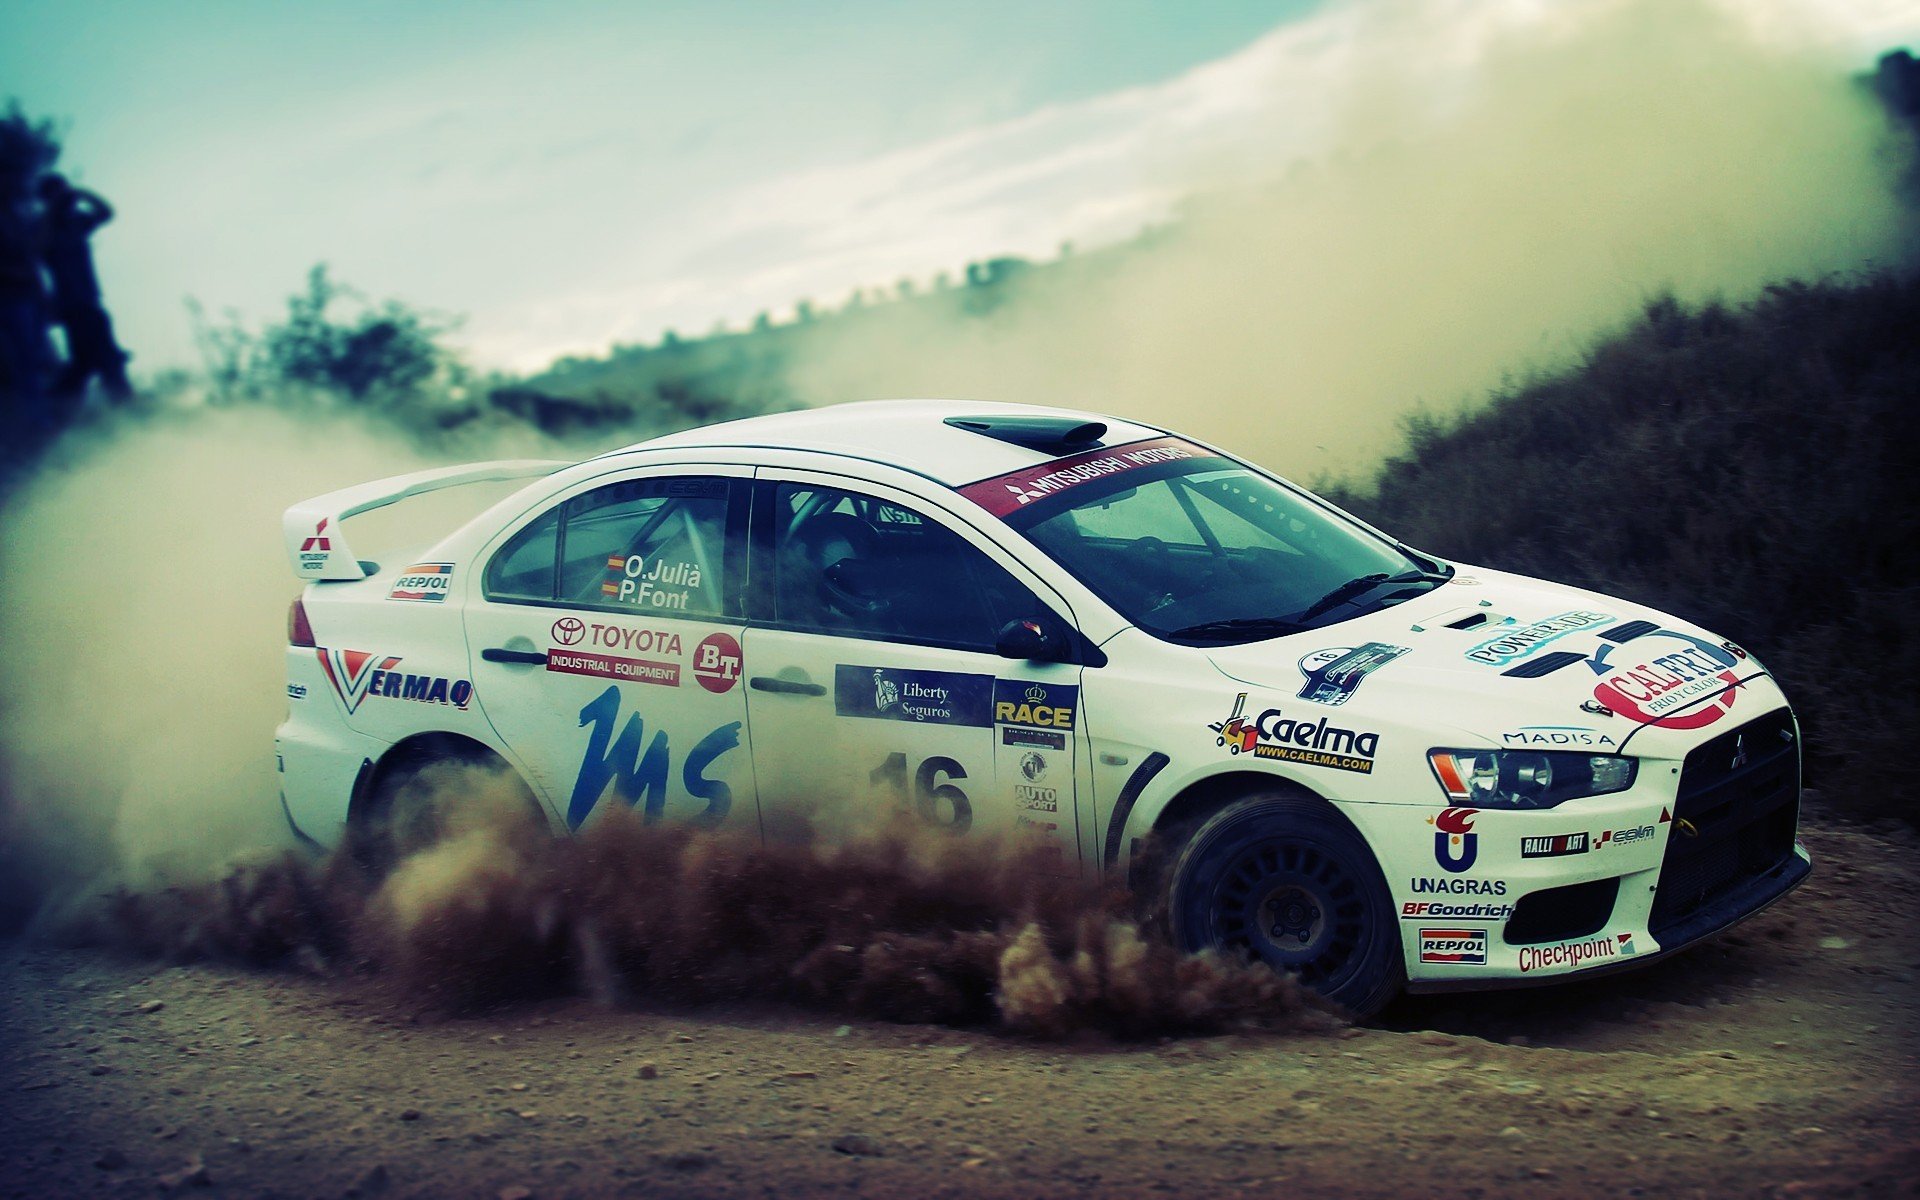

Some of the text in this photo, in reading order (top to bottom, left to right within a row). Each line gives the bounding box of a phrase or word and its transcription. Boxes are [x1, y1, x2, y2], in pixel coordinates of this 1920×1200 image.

[1029, 446, 1193, 494] MITSUBISHI MOTORS
[396, 577, 449, 590] REPSOL
[625, 555, 701, 588] O.Julià
[619, 579, 690, 610] P.Font
[591, 623, 682, 656] TOYOTA
[1470, 610, 1606, 662] POWERADE
[551, 655, 676, 681] INDUSTRIAL EQUIPMENT
[700, 644, 739, 680] BT
[1313, 652, 1338, 662] 16
[316, 648, 474, 715] VERMAQ
[903, 683, 949, 704] Liberty
[1648, 693, 1678, 713] FRIO
[1683, 677, 1721, 698] CALOR
[902, 702, 951, 720] Seguros
[996, 701, 1072, 728] RACE
[1256, 708, 1380, 759] Caelma
[1503, 732, 1616, 746] MADISA
[1256, 745, 1371, 771] WWW.CAELMA.COM
[869, 752, 973, 838] 16
[1016, 786, 1056, 801] AUTO
[1411, 877, 1507, 895] UNAGRAS
[1402, 902, 1513, 917] BFGoodrich
[1423, 940, 1484, 951] REPSOL
[1519, 937, 1615, 972] Checkpoint
